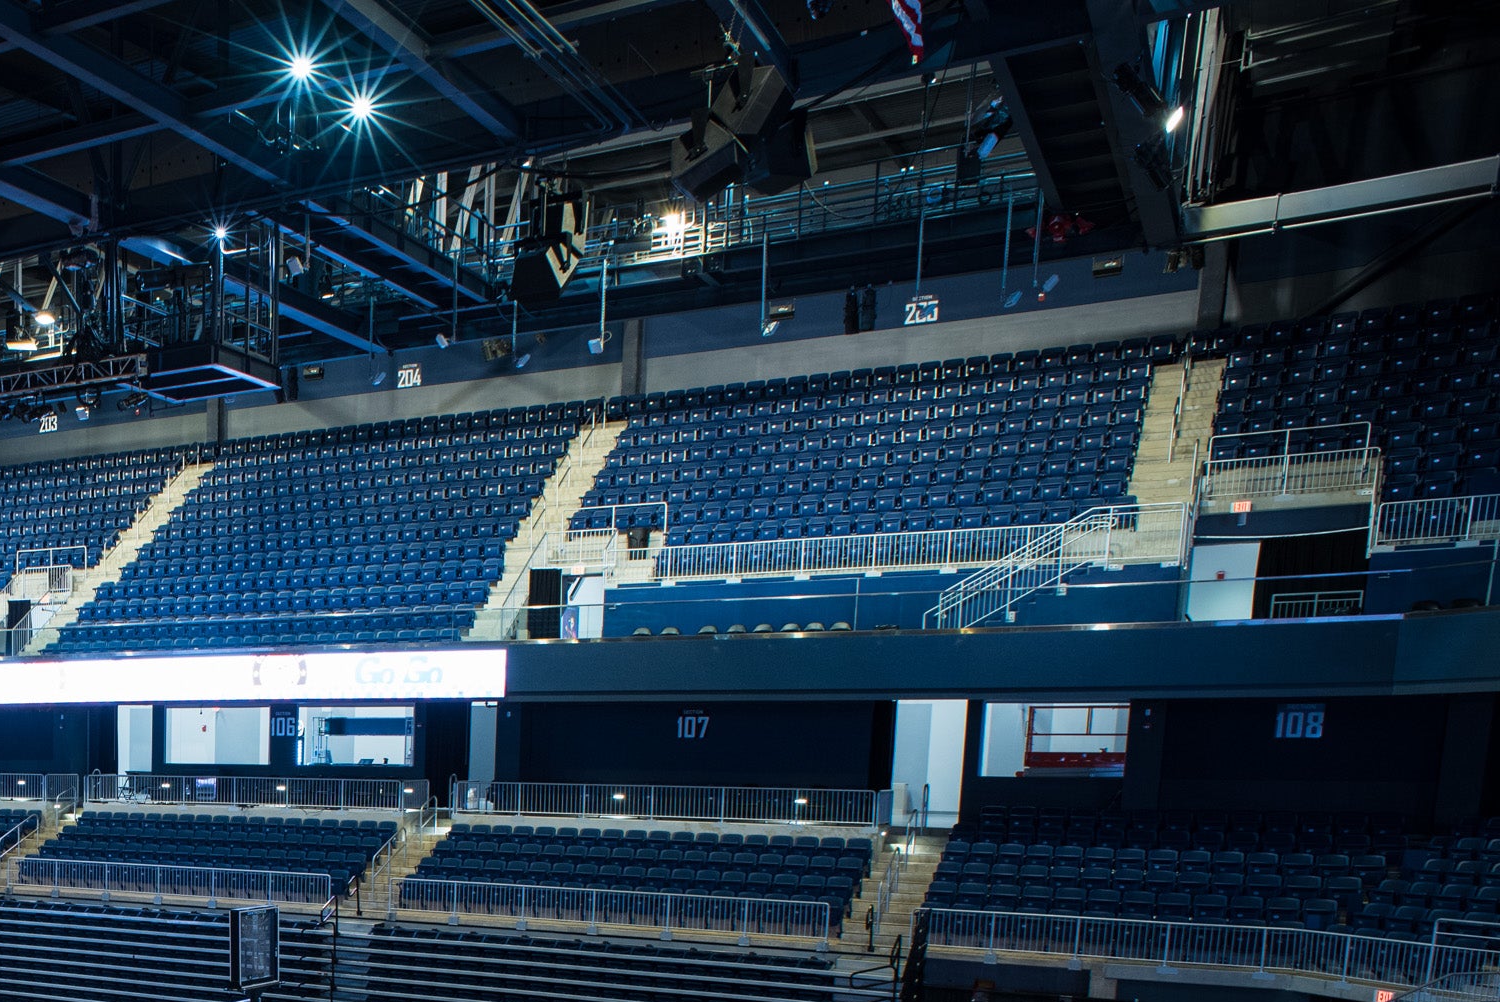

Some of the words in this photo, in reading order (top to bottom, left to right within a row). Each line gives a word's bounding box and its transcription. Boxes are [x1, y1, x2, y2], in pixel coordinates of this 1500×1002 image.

[397, 368, 421, 388] 204
[39, 415, 58, 433] 203
[270, 717, 296, 737] 106
[677, 716, 709, 738] 107
[1274, 711, 1325, 738] 108
